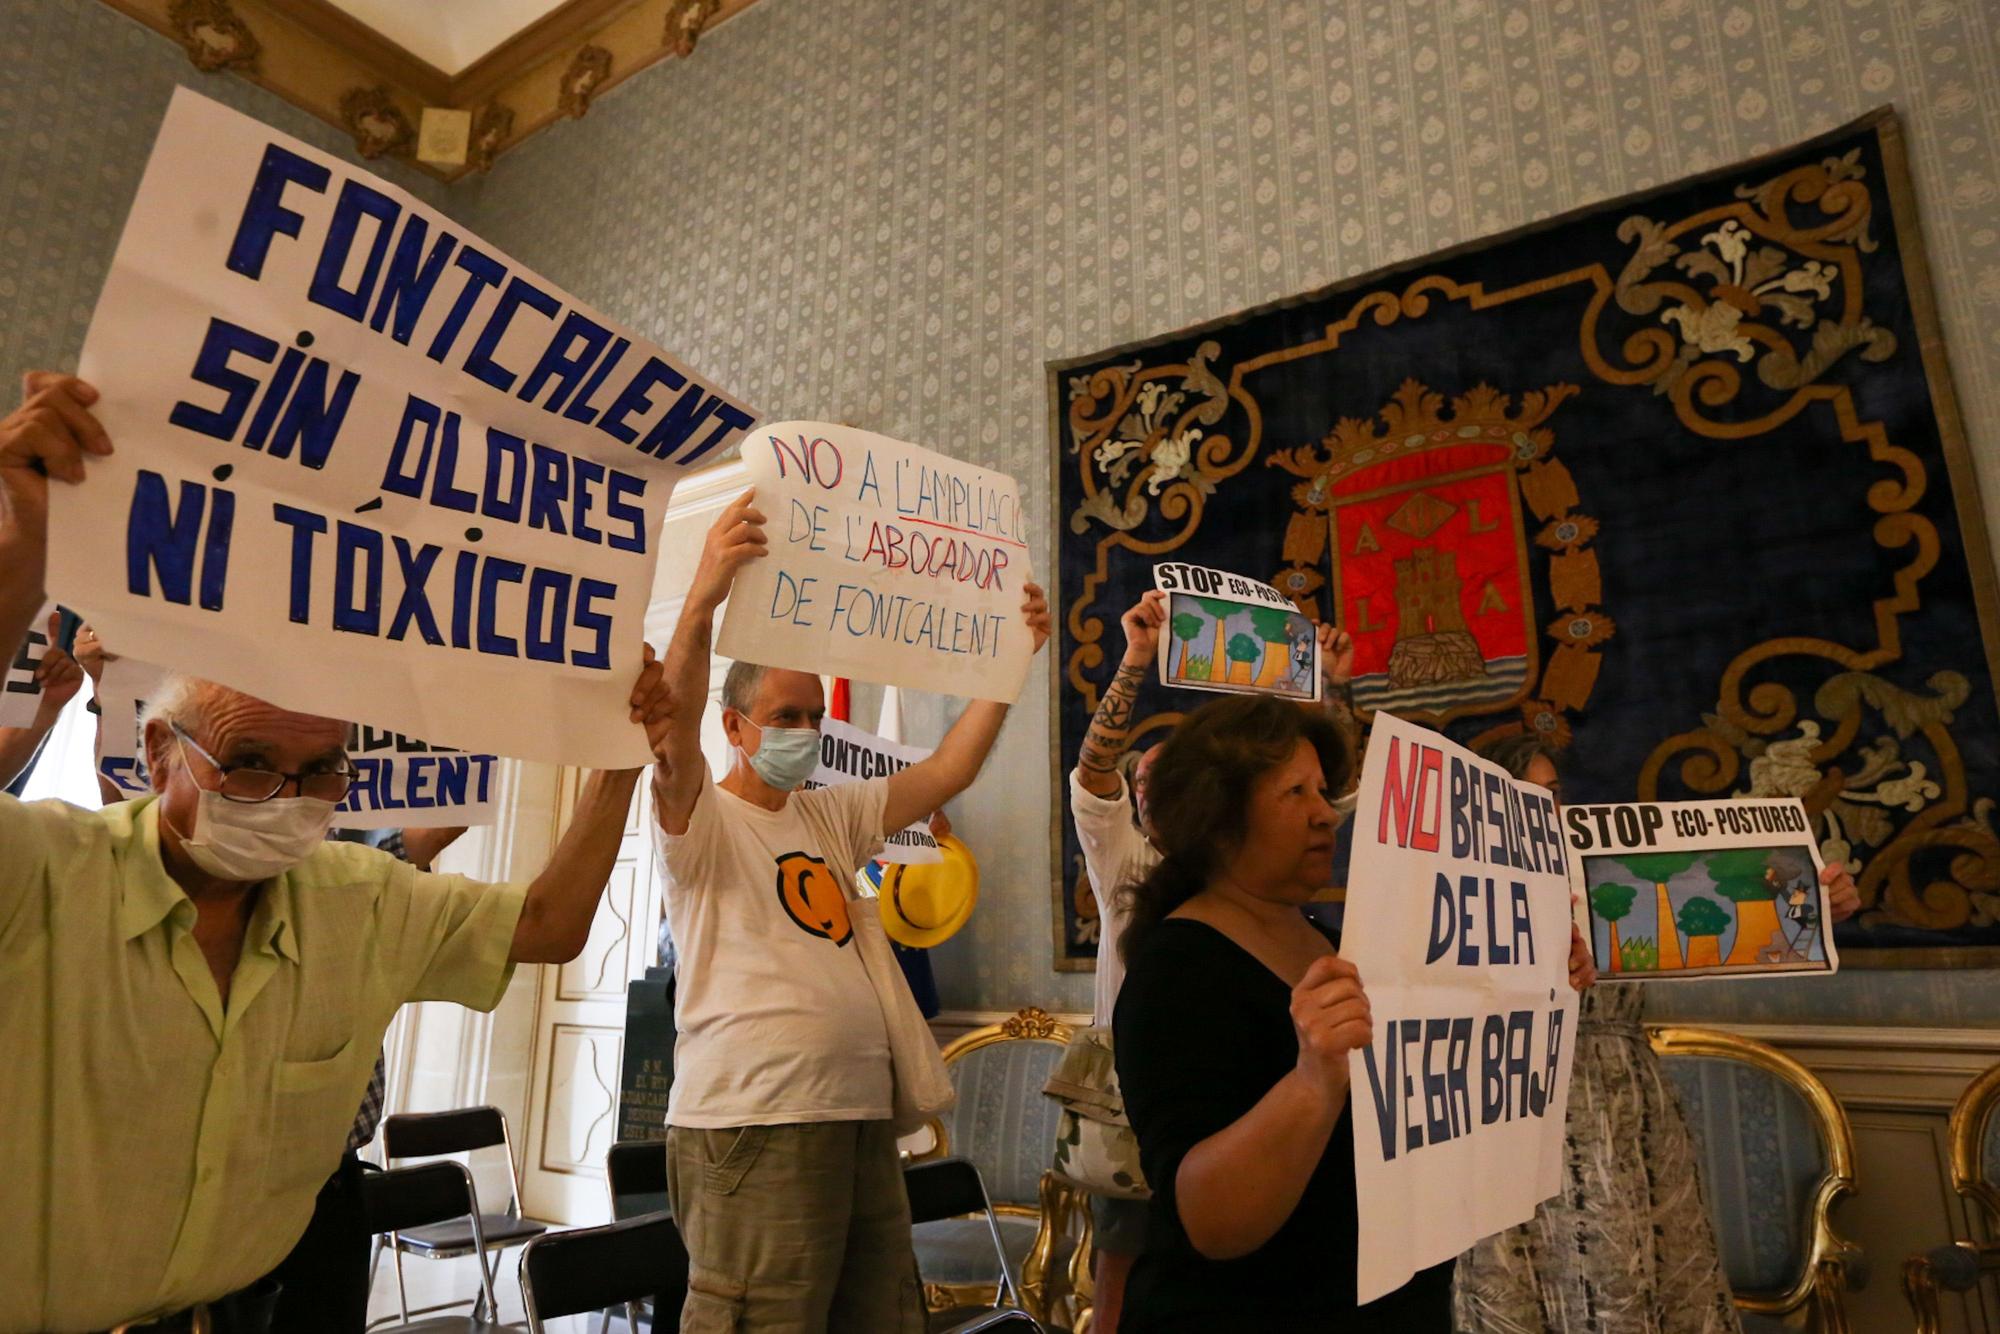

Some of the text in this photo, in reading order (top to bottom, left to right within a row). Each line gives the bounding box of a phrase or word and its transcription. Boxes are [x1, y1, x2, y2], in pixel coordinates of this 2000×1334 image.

[226, 142, 756, 465] FONTCALENT
[169, 317, 648, 554] SIN OLORES
[769, 435, 843, 489] NO
[859, 450, 882, 508] A
[127, 463, 619, 671] NI TÓXICOS
[789, 499, 1009, 592] DE L'ABOCADOR
[1158, 564, 1223, 595] STOP
[771, 571, 1006, 657] DE FONTCALENT
[1378, 736, 1565, 876] NO BASURAS
[1566, 805, 1663, 850] STOP
[1363, 987, 1564, 1162] VEGA BAJA
